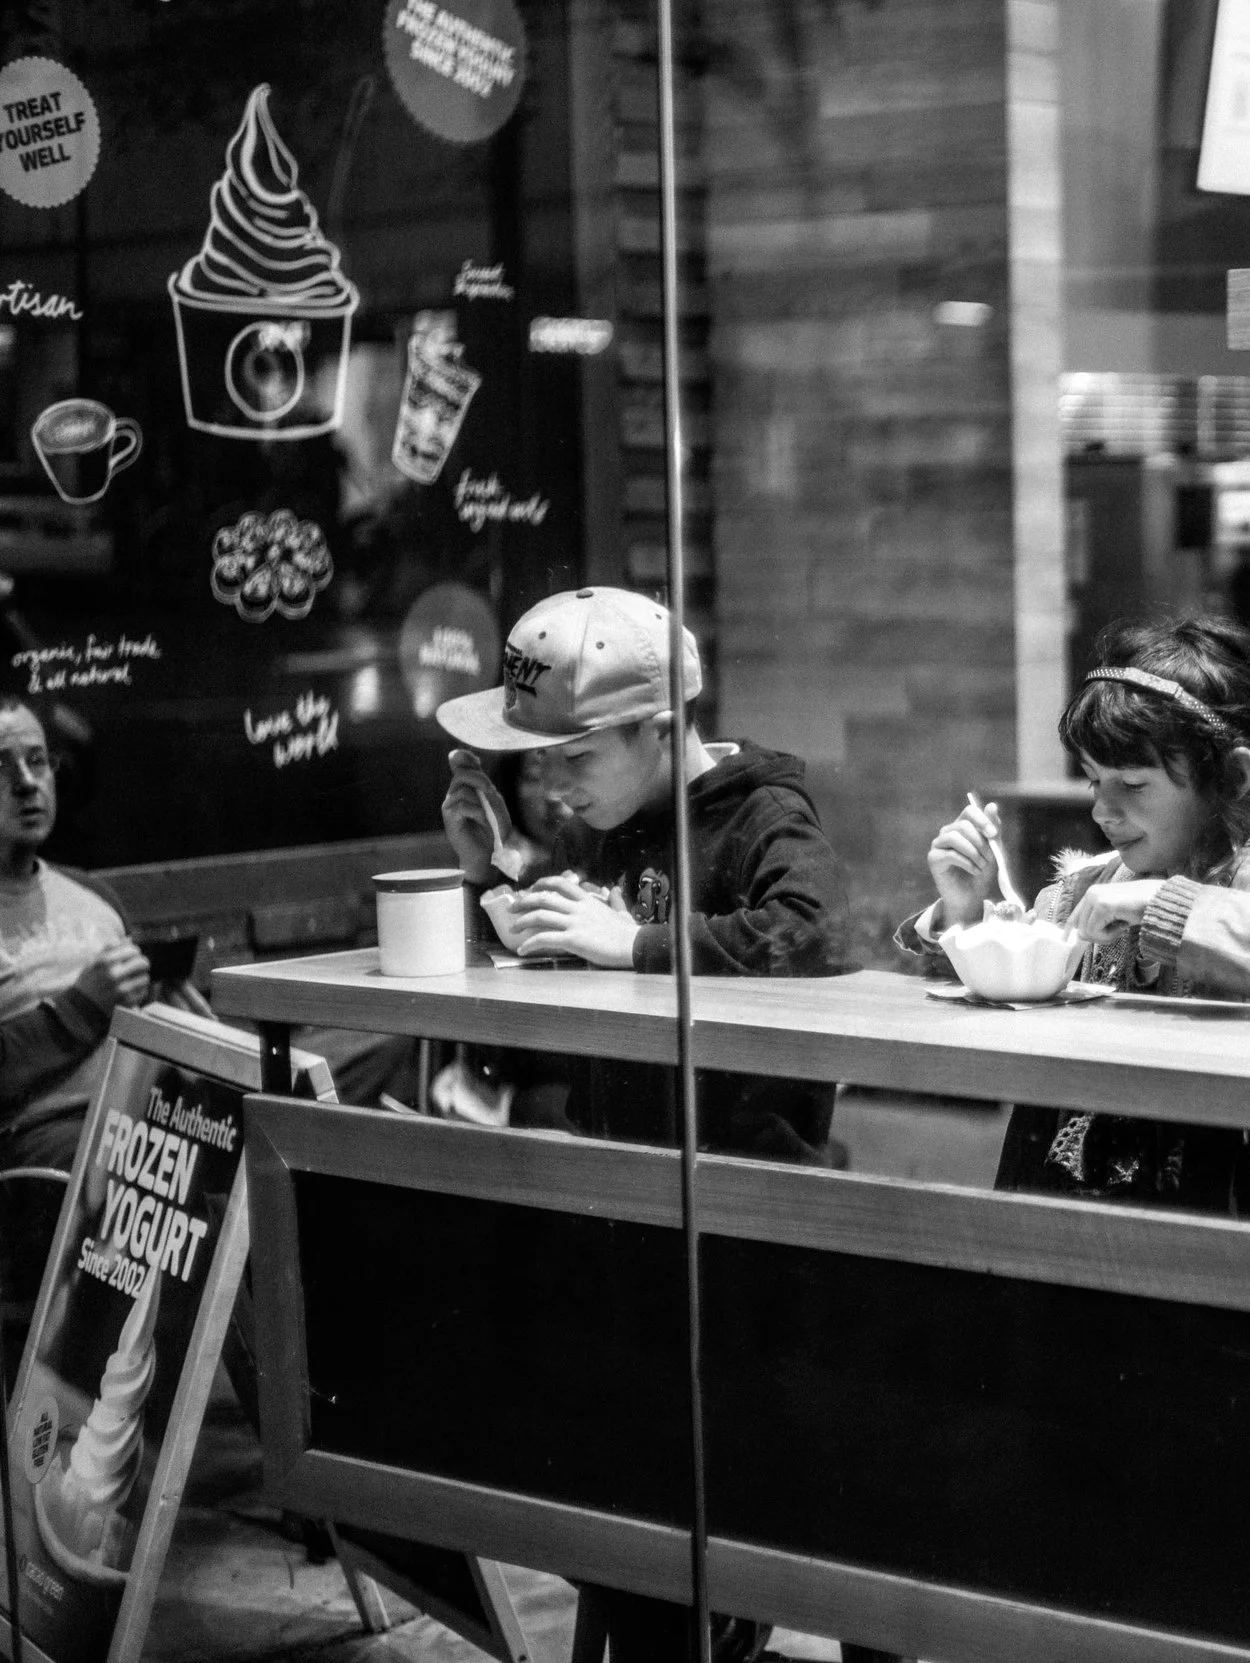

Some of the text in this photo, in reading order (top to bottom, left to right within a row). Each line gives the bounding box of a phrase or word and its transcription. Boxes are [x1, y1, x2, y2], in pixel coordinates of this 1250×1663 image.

[2, 91, 62, 124] TREAT
[19, 143, 71, 172] WELL
[149, 1086, 237, 1152] The Authentic
[95, 1108, 199, 1206] FROZEN
[101, 1179, 208, 1282] YOGURT
[77, 1236, 146, 1301] Since 2002
